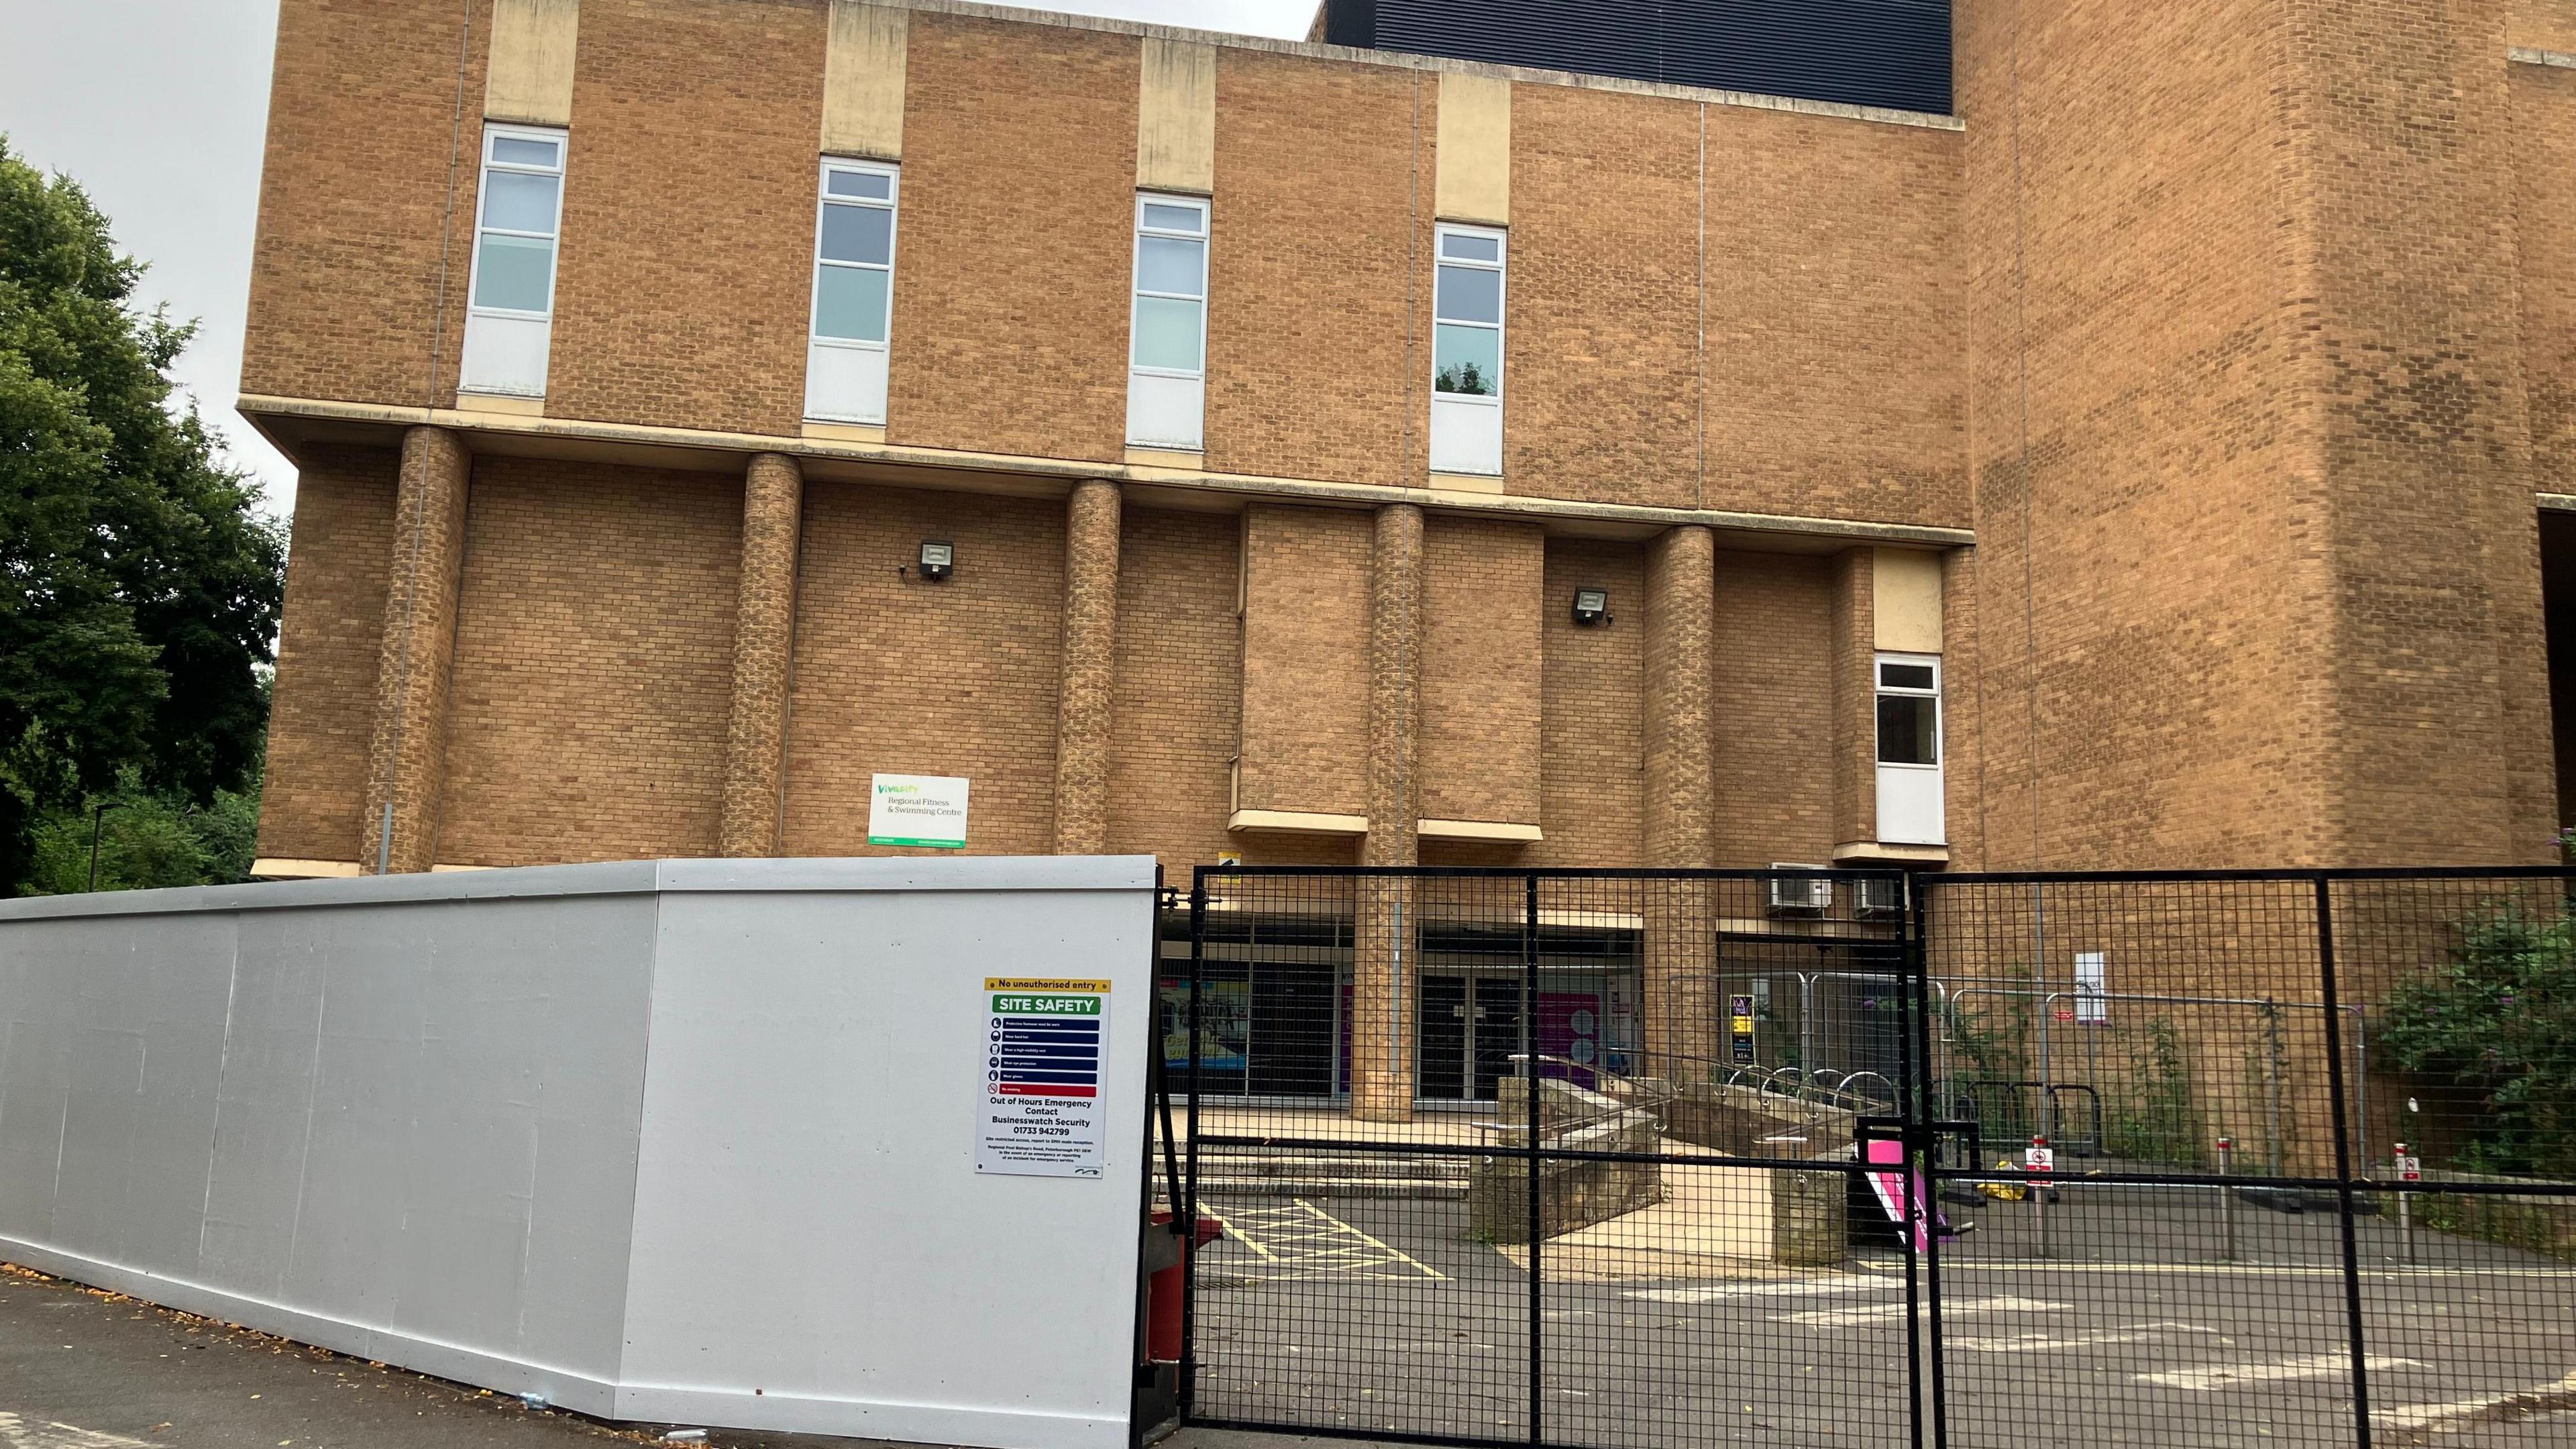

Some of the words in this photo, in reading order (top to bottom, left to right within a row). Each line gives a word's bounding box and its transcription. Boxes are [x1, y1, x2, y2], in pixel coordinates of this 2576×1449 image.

[888, 796, 921, 805] Regional
[895, 806, 936, 816] Swimming
[999, 979, 1010, 987] No
[1013, 979, 1070, 988] unauthorised
[1073, 981, 1096, 991] entry
[1000, 998, 1032, 1010] SITE
[1035, 999, 1094, 1012] SAFETY
[1044, 1099, 1091, 1108] Emergency
[992, 1116, 1053, 1125] Businesswatch
[1055, 1118, 1090, 1128] Security
